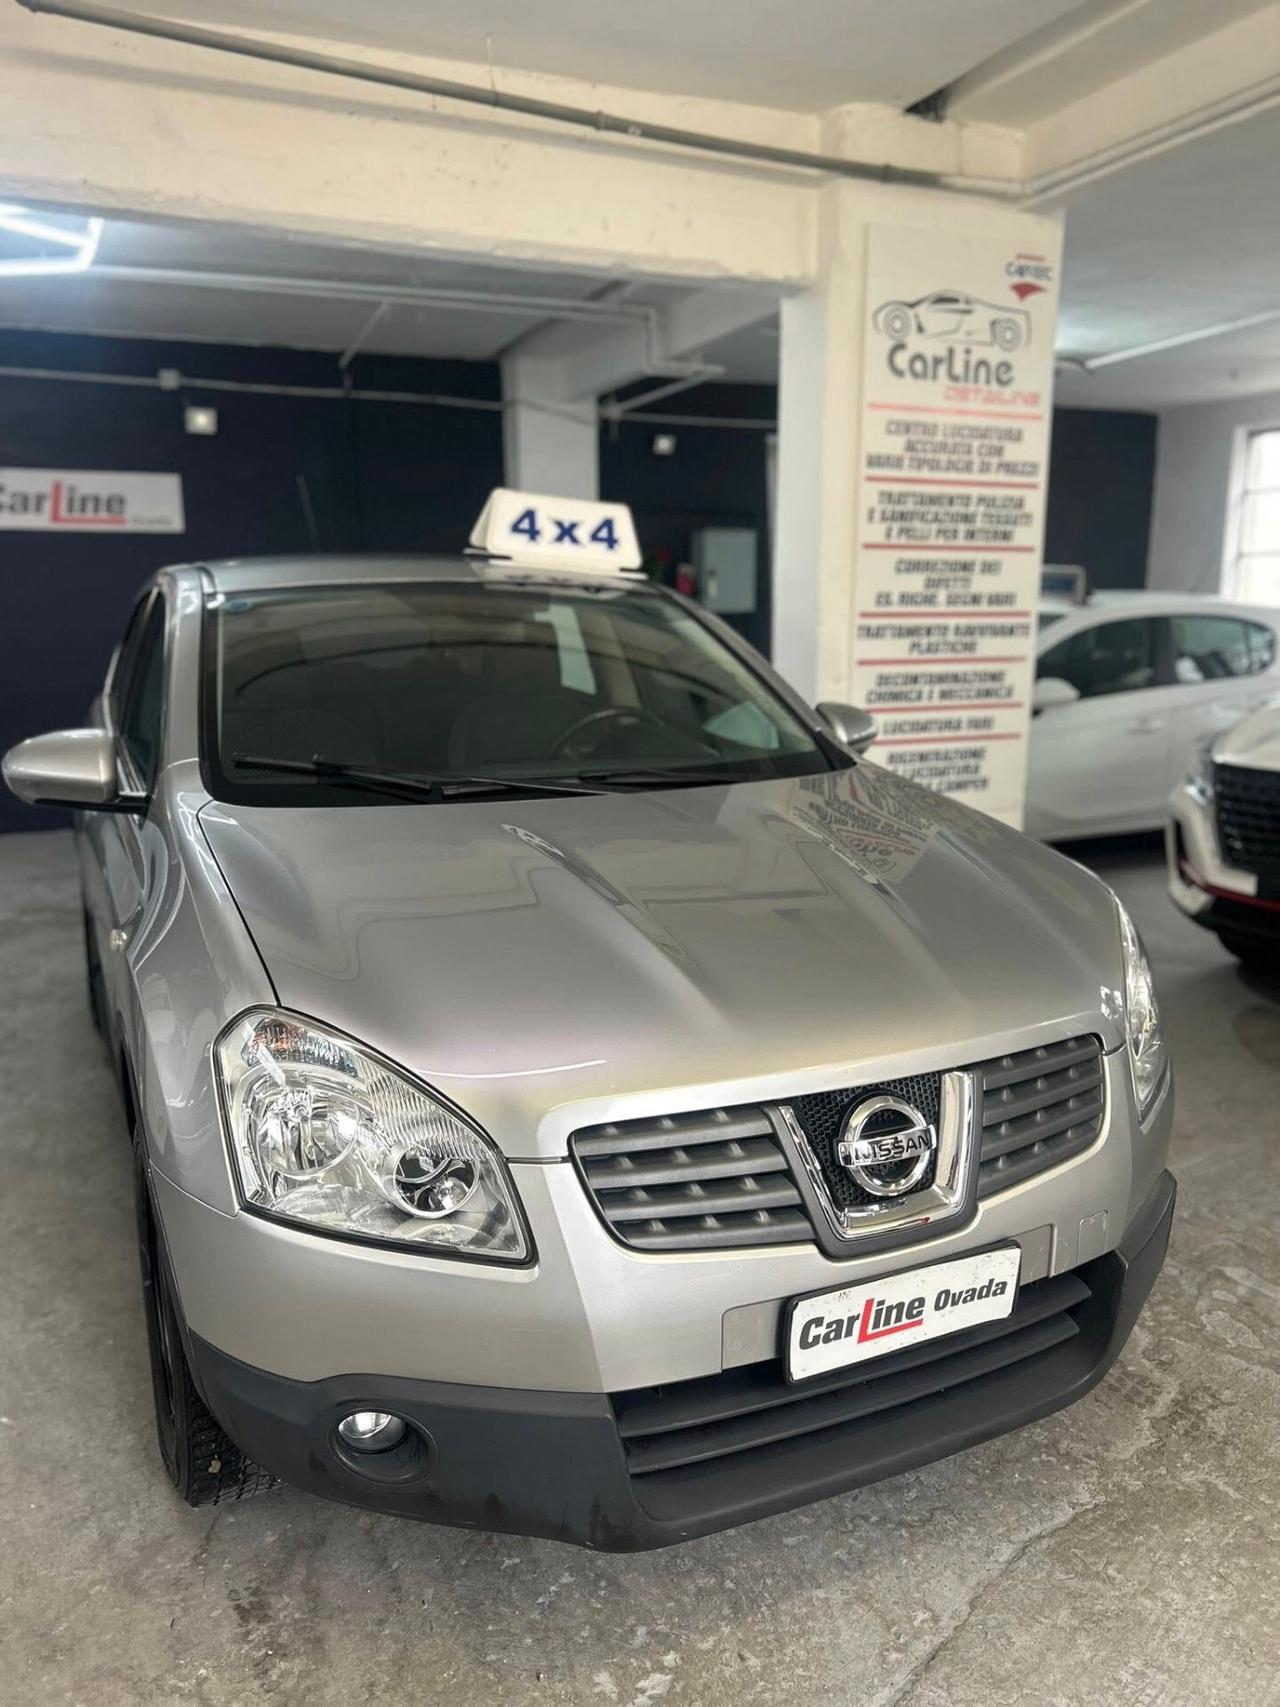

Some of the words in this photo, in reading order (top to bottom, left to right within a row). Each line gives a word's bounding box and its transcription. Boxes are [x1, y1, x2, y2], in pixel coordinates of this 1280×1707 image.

[887, 343, 1014, 386] CarLine
[885, 419, 938, 436] CENTRO
[943, 423, 1024, 442] LUCIDATURA
[854, 1132, 932, 1164] NISSAN
[799, 1296, 926, 1350] CarLine
[933, 1278, 1008, 1312] Ovada
